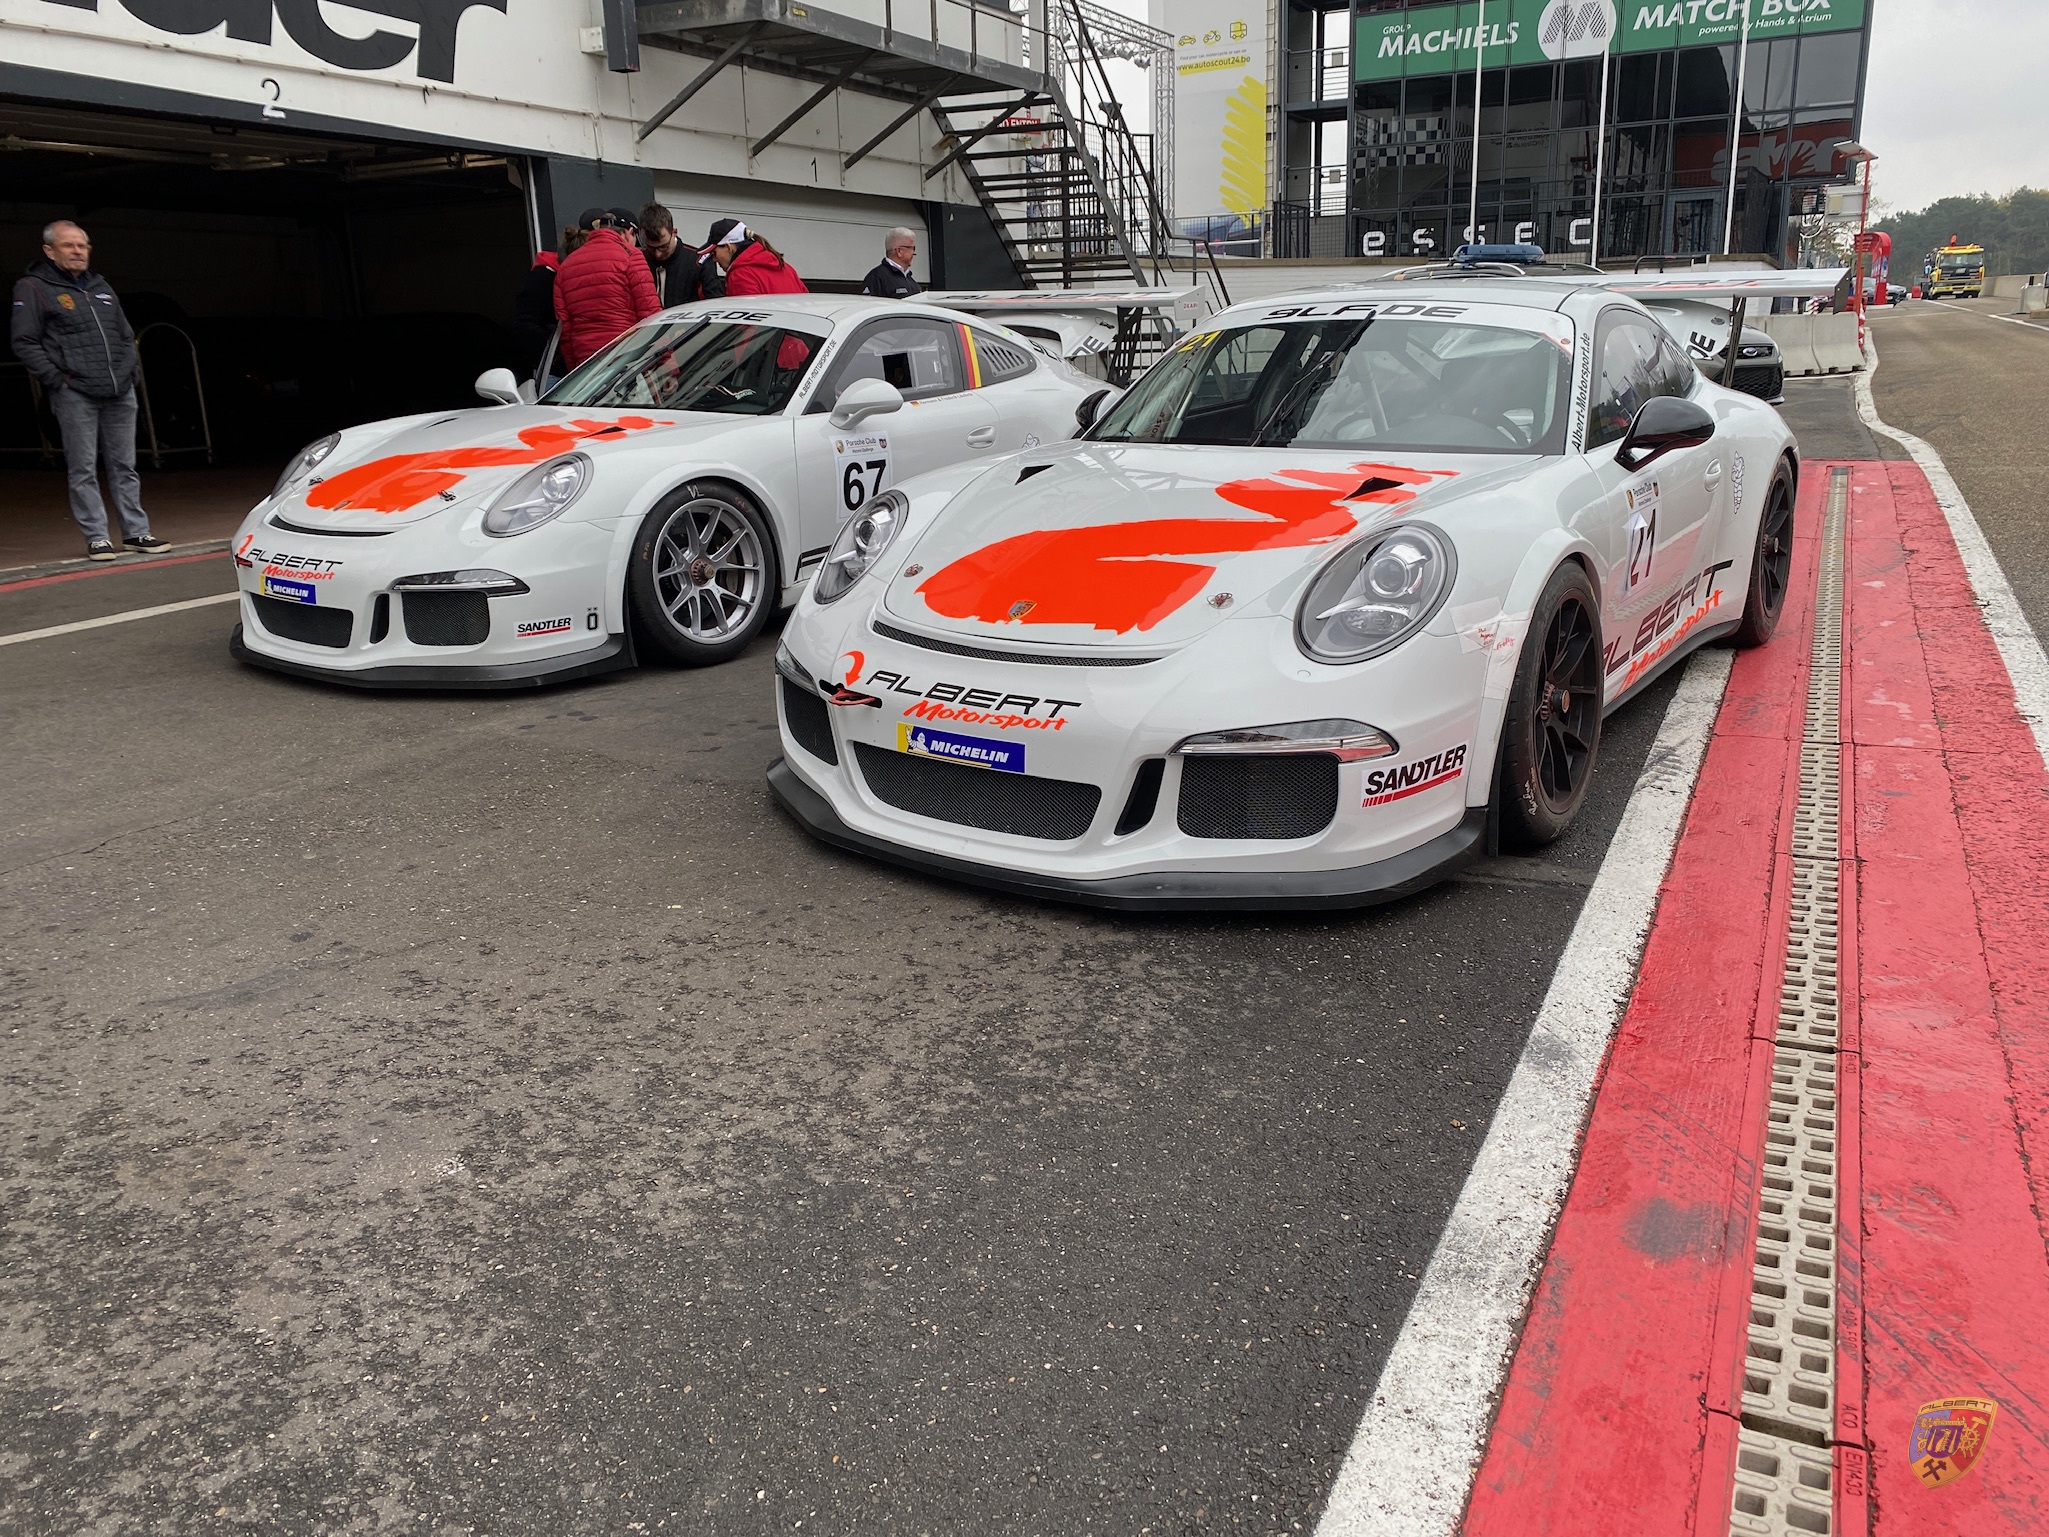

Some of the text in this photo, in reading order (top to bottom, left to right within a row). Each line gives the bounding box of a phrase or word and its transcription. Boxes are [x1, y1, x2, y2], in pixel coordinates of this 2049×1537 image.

[1633, 0, 1746, 30] MATCH
[1699, 24, 1739, 37] powered
[1755, 16, 1785, 29] Hands
[1788, 16, 1796, 25] &
[1798, 13, 1832, 23] Atrium
[1377, 21, 1520, 59] MACHIELS
[1176, 56, 1251, 71] www.autoscout24.be
[260, 78, 286, 119] 2
[810, 156, 818, 183] 1
[1178, 330, 1222, 353] 21
[1571, 332, 1592, 454] Albert-Motorsport.de
[846, 437, 877, 447] Porsche Club
[843, 459, 887, 511] 67
[245, 547, 344, 573] ALBERT
[261, 564, 336, 581] Motorsport
[272, 584, 309, 598] MICHELIN
[517, 617, 571, 633] SANDTLER
[865, 670, 1083, 718] ALBERT
[903, 699, 1069, 731] Motorsport
[929, 739, 1010, 764] MICHELIN
[1365, 744, 1467, 796] SANDTLER
[1841, 1403, 1858, 1429] ACO
